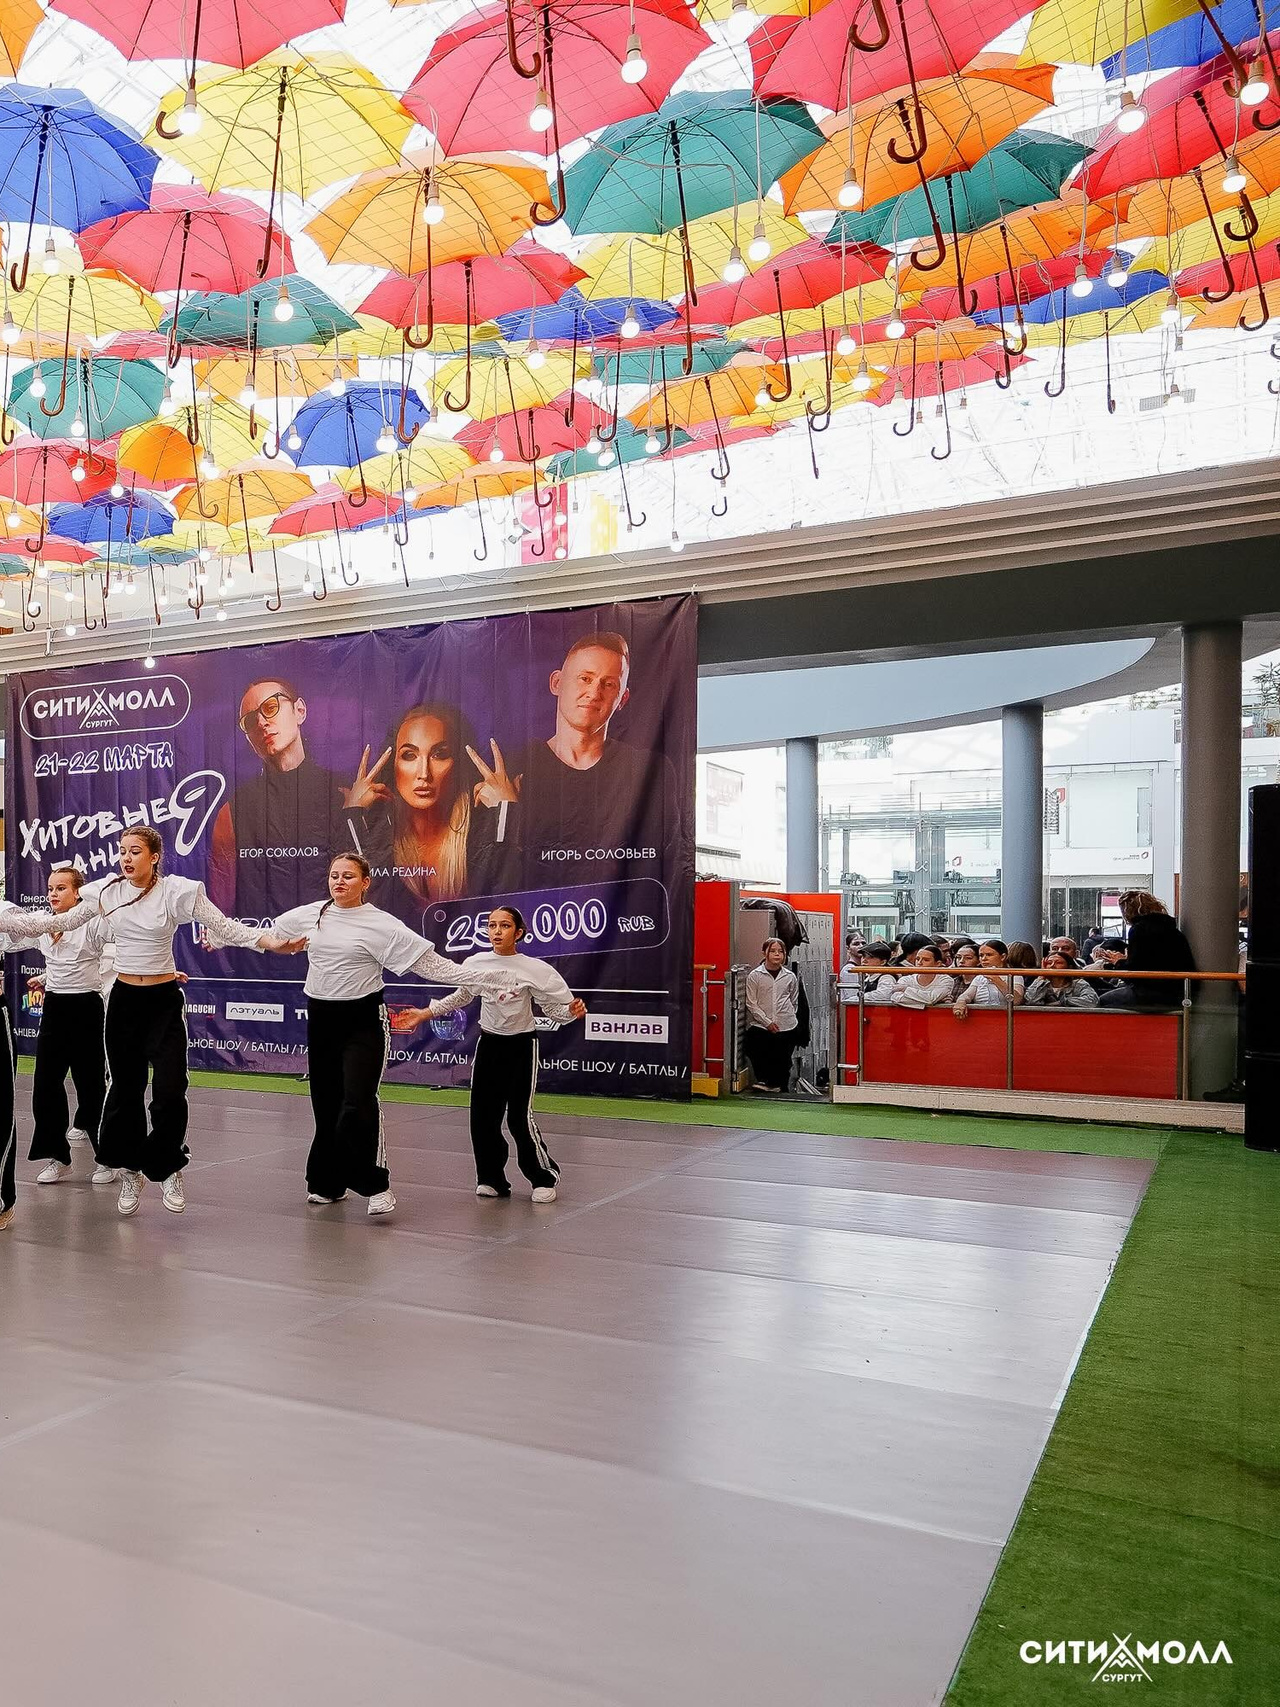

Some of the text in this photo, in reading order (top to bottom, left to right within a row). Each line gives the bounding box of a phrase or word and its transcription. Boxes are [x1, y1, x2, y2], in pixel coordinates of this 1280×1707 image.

[33, 687, 176, 719] СИТИ МОЛЛ
[85, 719, 115, 729] СУРГУТ
[34, 741, 174, 777] 21-22 МАРТА
[239, 846, 319, 859] ЕГОР СОКОЛОВ
[540, 847, 657, 861] ИГОРЬ СОЛОВЬЕВ
[369, 866, 437, 878] ИЛА РЕДИНА
[445, 898, 655, 953] 25.000 RUB
[590, 1021, 664, 1036] ванлав
[216, 1040, 243, 1051] ШОУ
[251, 1041, 290, 1054] БАТТЛЫ
[425, 1051, 469, 1065] БАТТЛЫ
[581, 1060, 616, 1073] ШОУ
[629, 1063, 679, 1078] БАТТЛЫ
